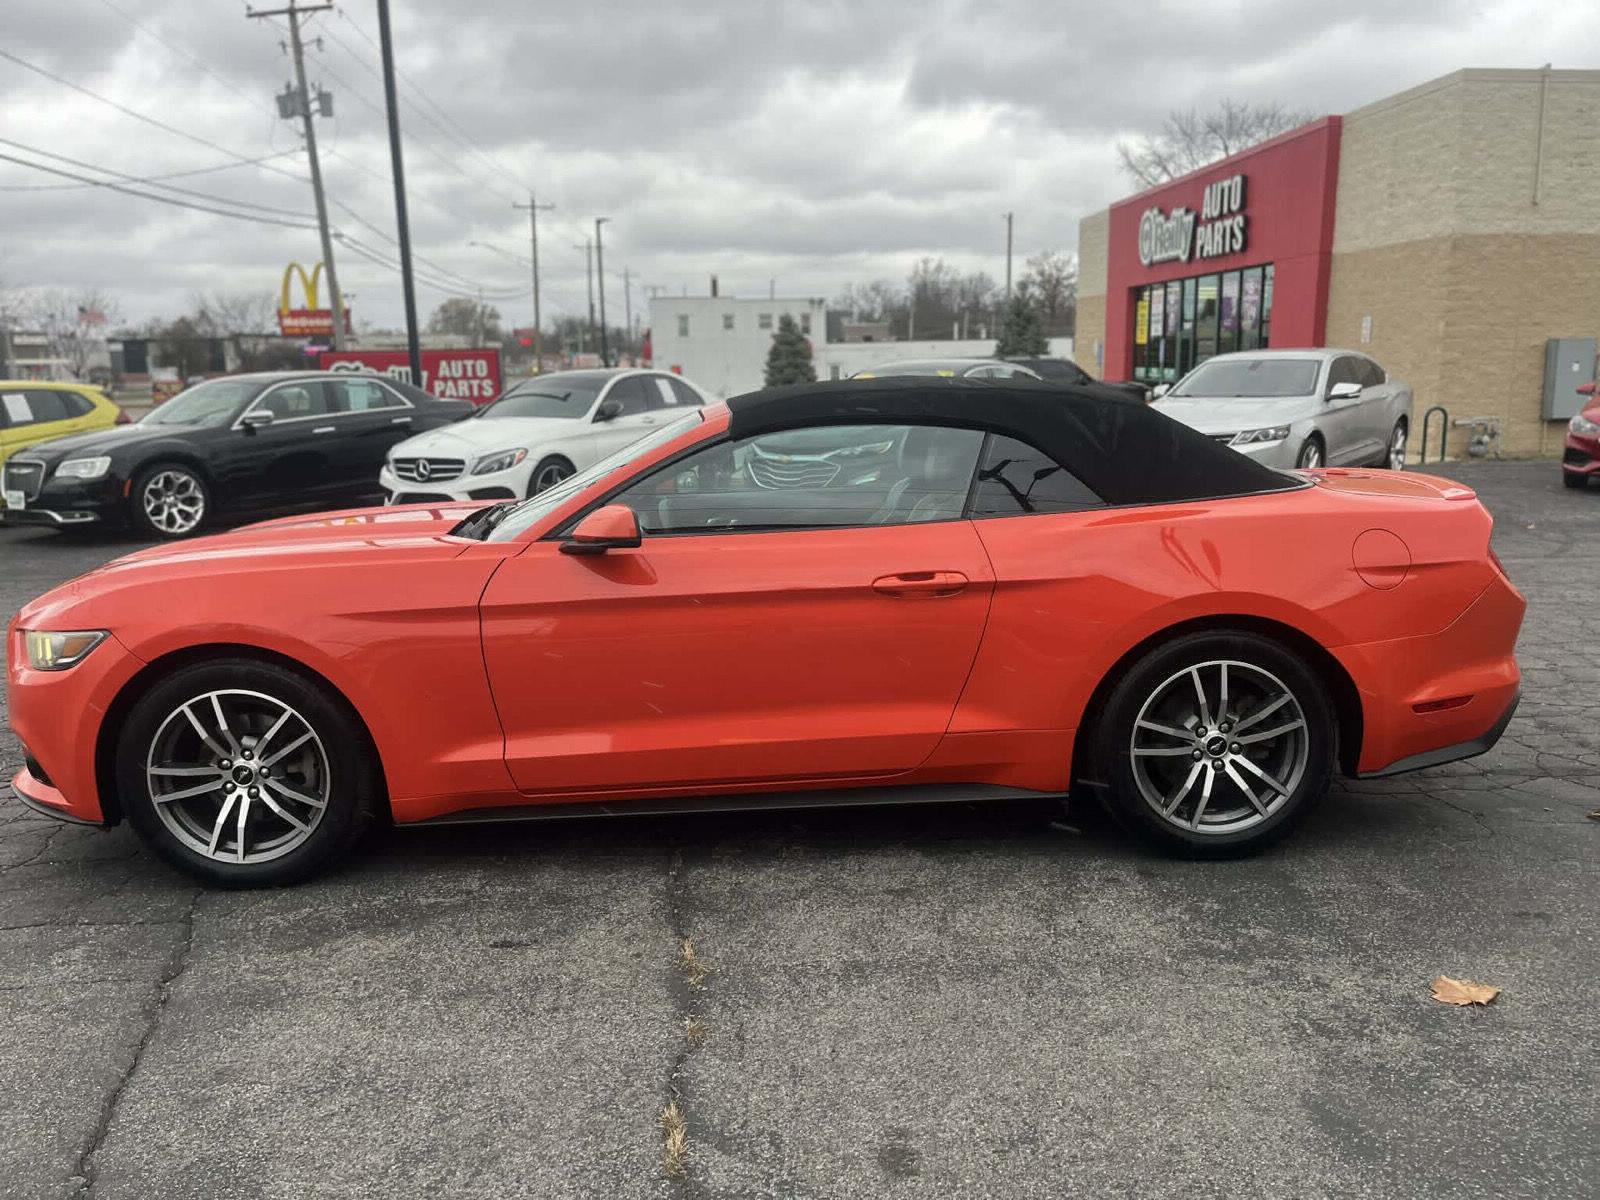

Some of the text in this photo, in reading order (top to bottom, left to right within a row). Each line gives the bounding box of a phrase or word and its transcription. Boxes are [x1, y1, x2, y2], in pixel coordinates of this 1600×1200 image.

[1202, 174, 1245, 220] AUTO
[1195, 215, 1246, 260] PARTS
[438, 360, 488, 378] AUTO
[433, 379, 494, 397] PARTS
